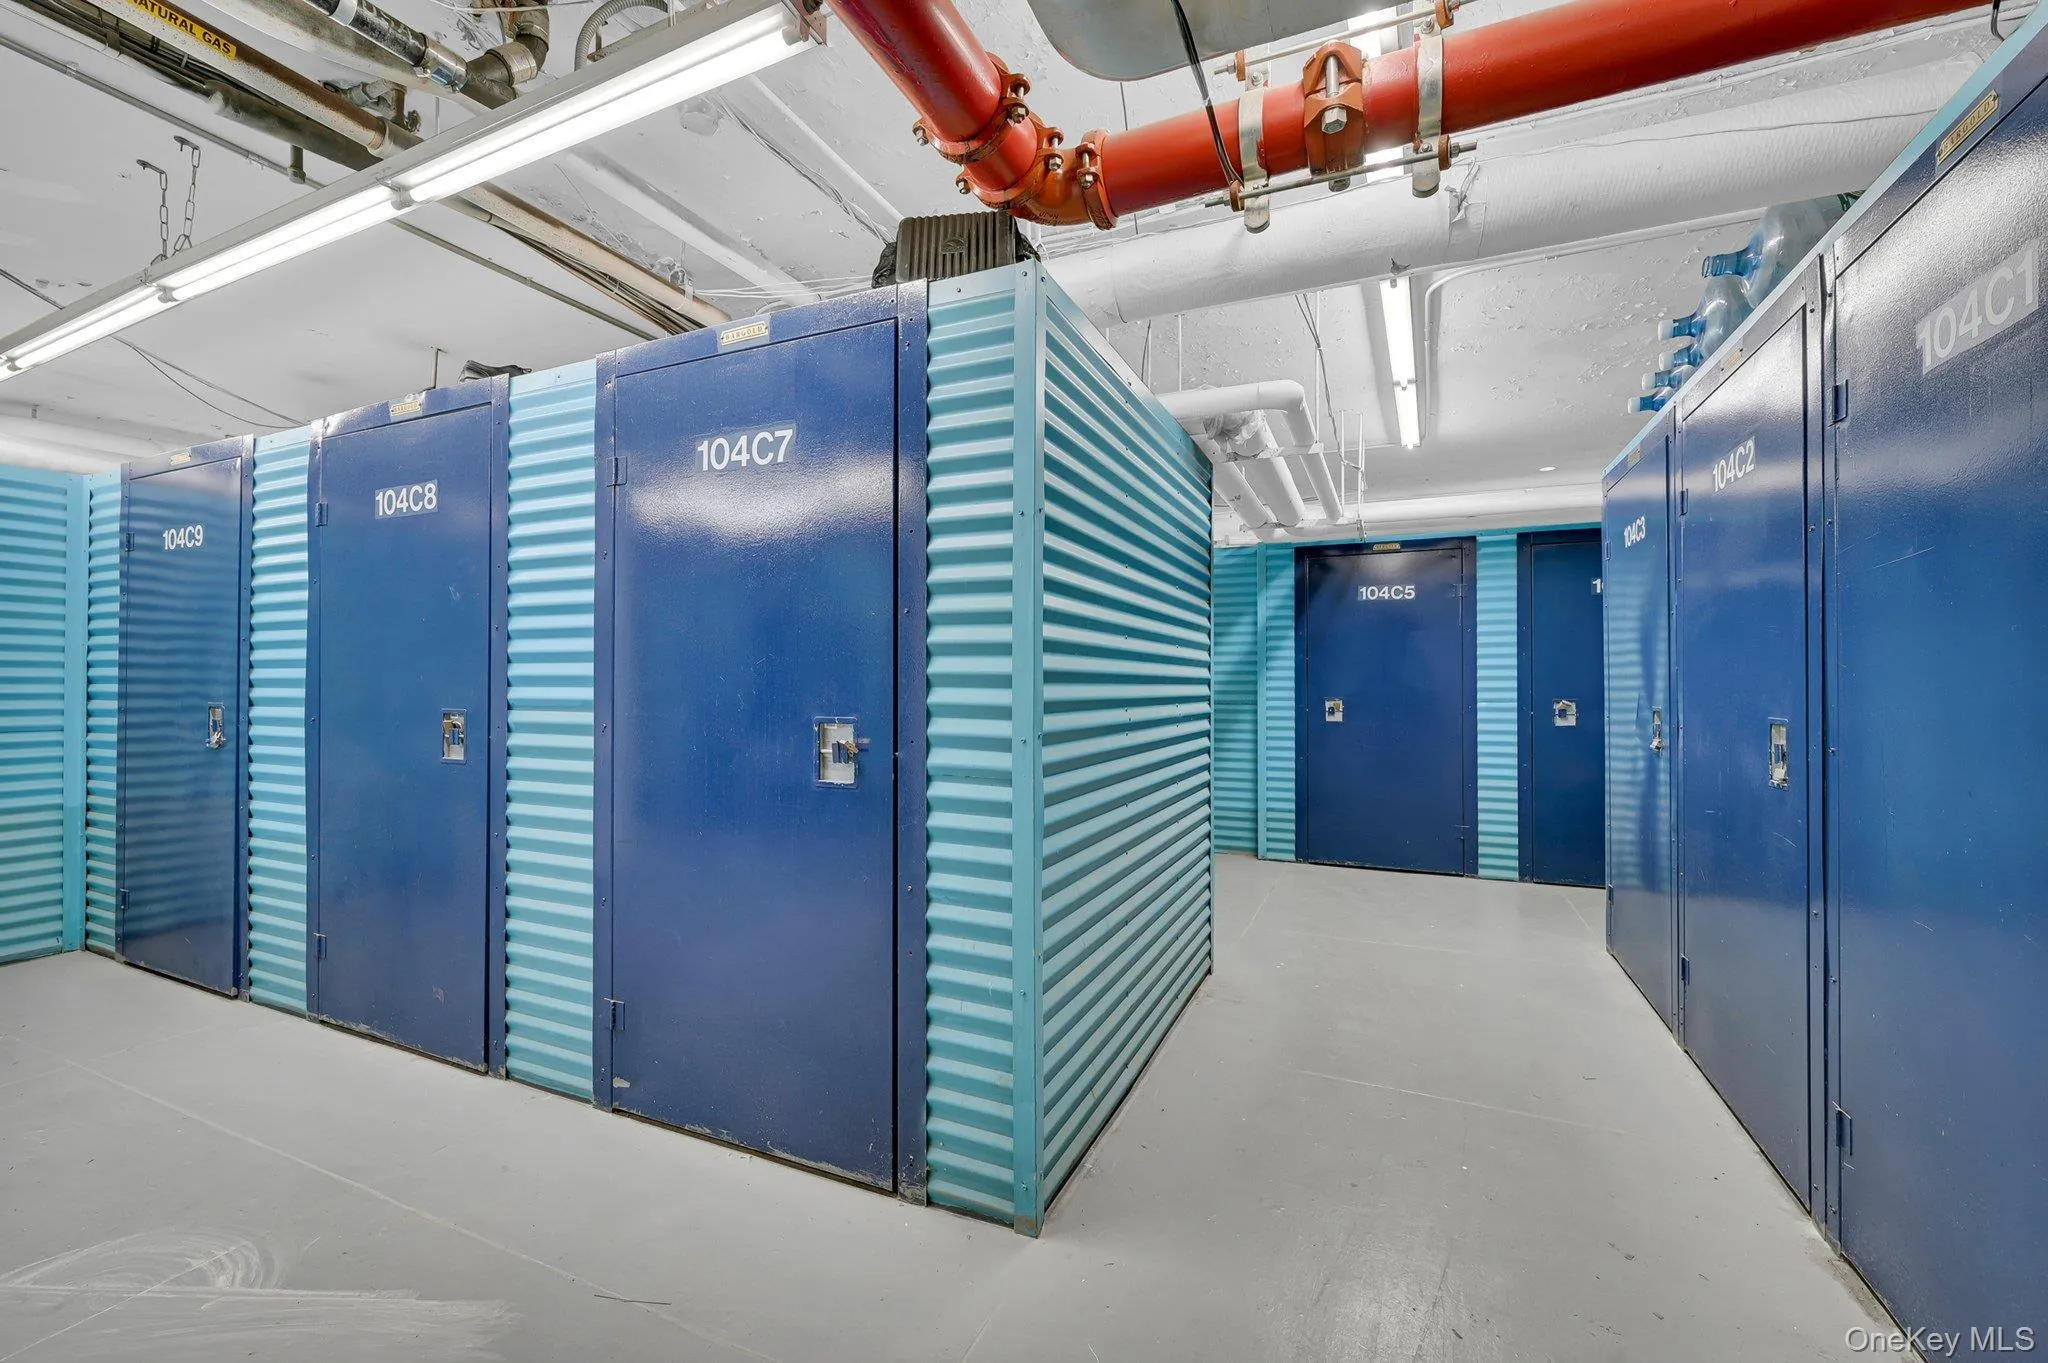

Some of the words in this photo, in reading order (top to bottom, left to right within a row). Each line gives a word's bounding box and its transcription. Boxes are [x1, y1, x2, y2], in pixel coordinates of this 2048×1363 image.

[202, 31, 231, 54] GAS
[1917, 248, 2034, 375] 104C1
[697, 428, 793, 471] 104C7
[1712, 439, 1755, 492] 104C2
[375, 483, 437, 516] 104C8
[162, 524, 204, 550] 104C9
[1623, 515, 1646, 548] 104C3
[1359, 585, 1416, 600] 104C5
[1592, 578, 1604, 594] 1
